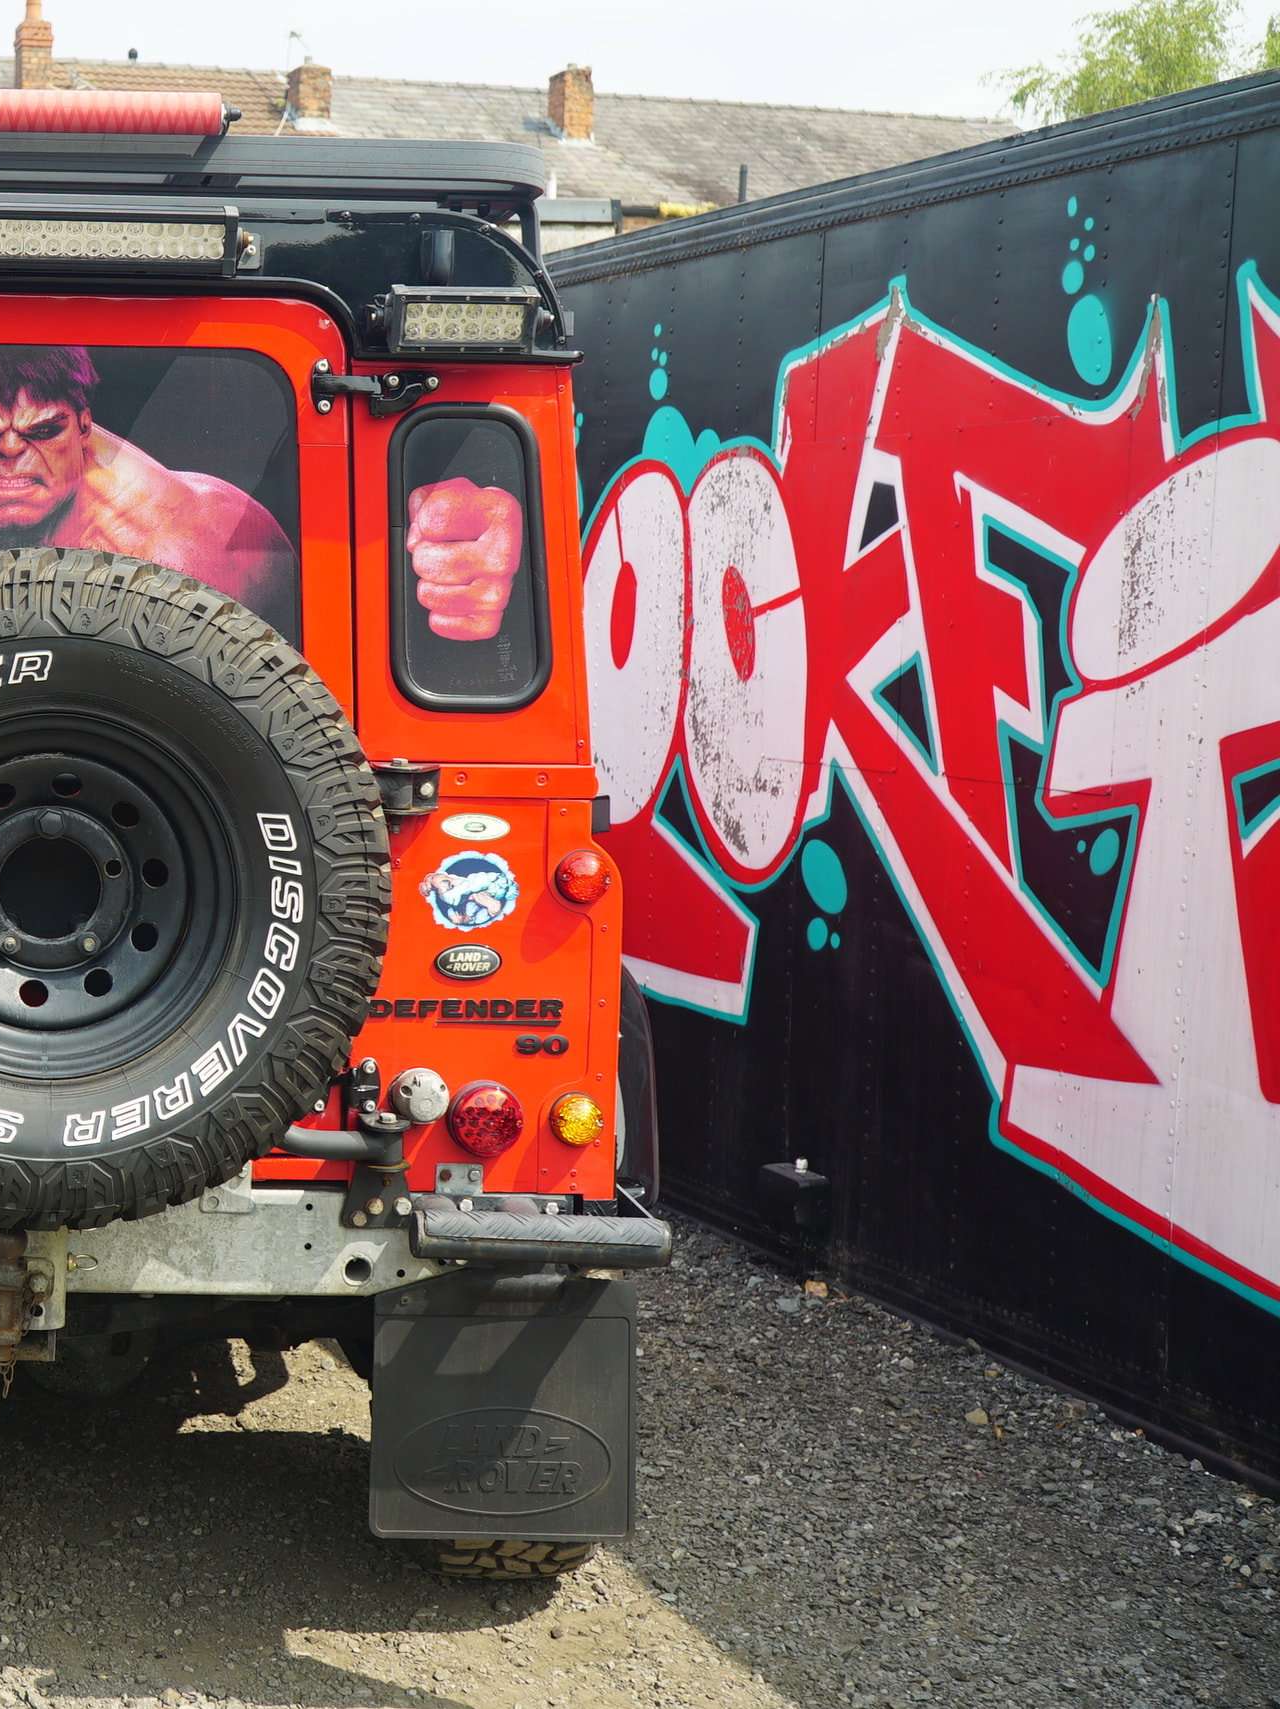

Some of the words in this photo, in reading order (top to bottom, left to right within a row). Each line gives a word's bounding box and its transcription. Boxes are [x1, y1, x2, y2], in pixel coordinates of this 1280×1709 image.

[449, 952, 482, 962] LAND
[452, 962, 491, 972] ROVER
[63, 812, 304, 1147] DISCOVERER
[370, 998, 564, 1019] DEFENDER
[515, 1034, 569, 1055] 90
[442, 1460, 584, 1495] ROVER
